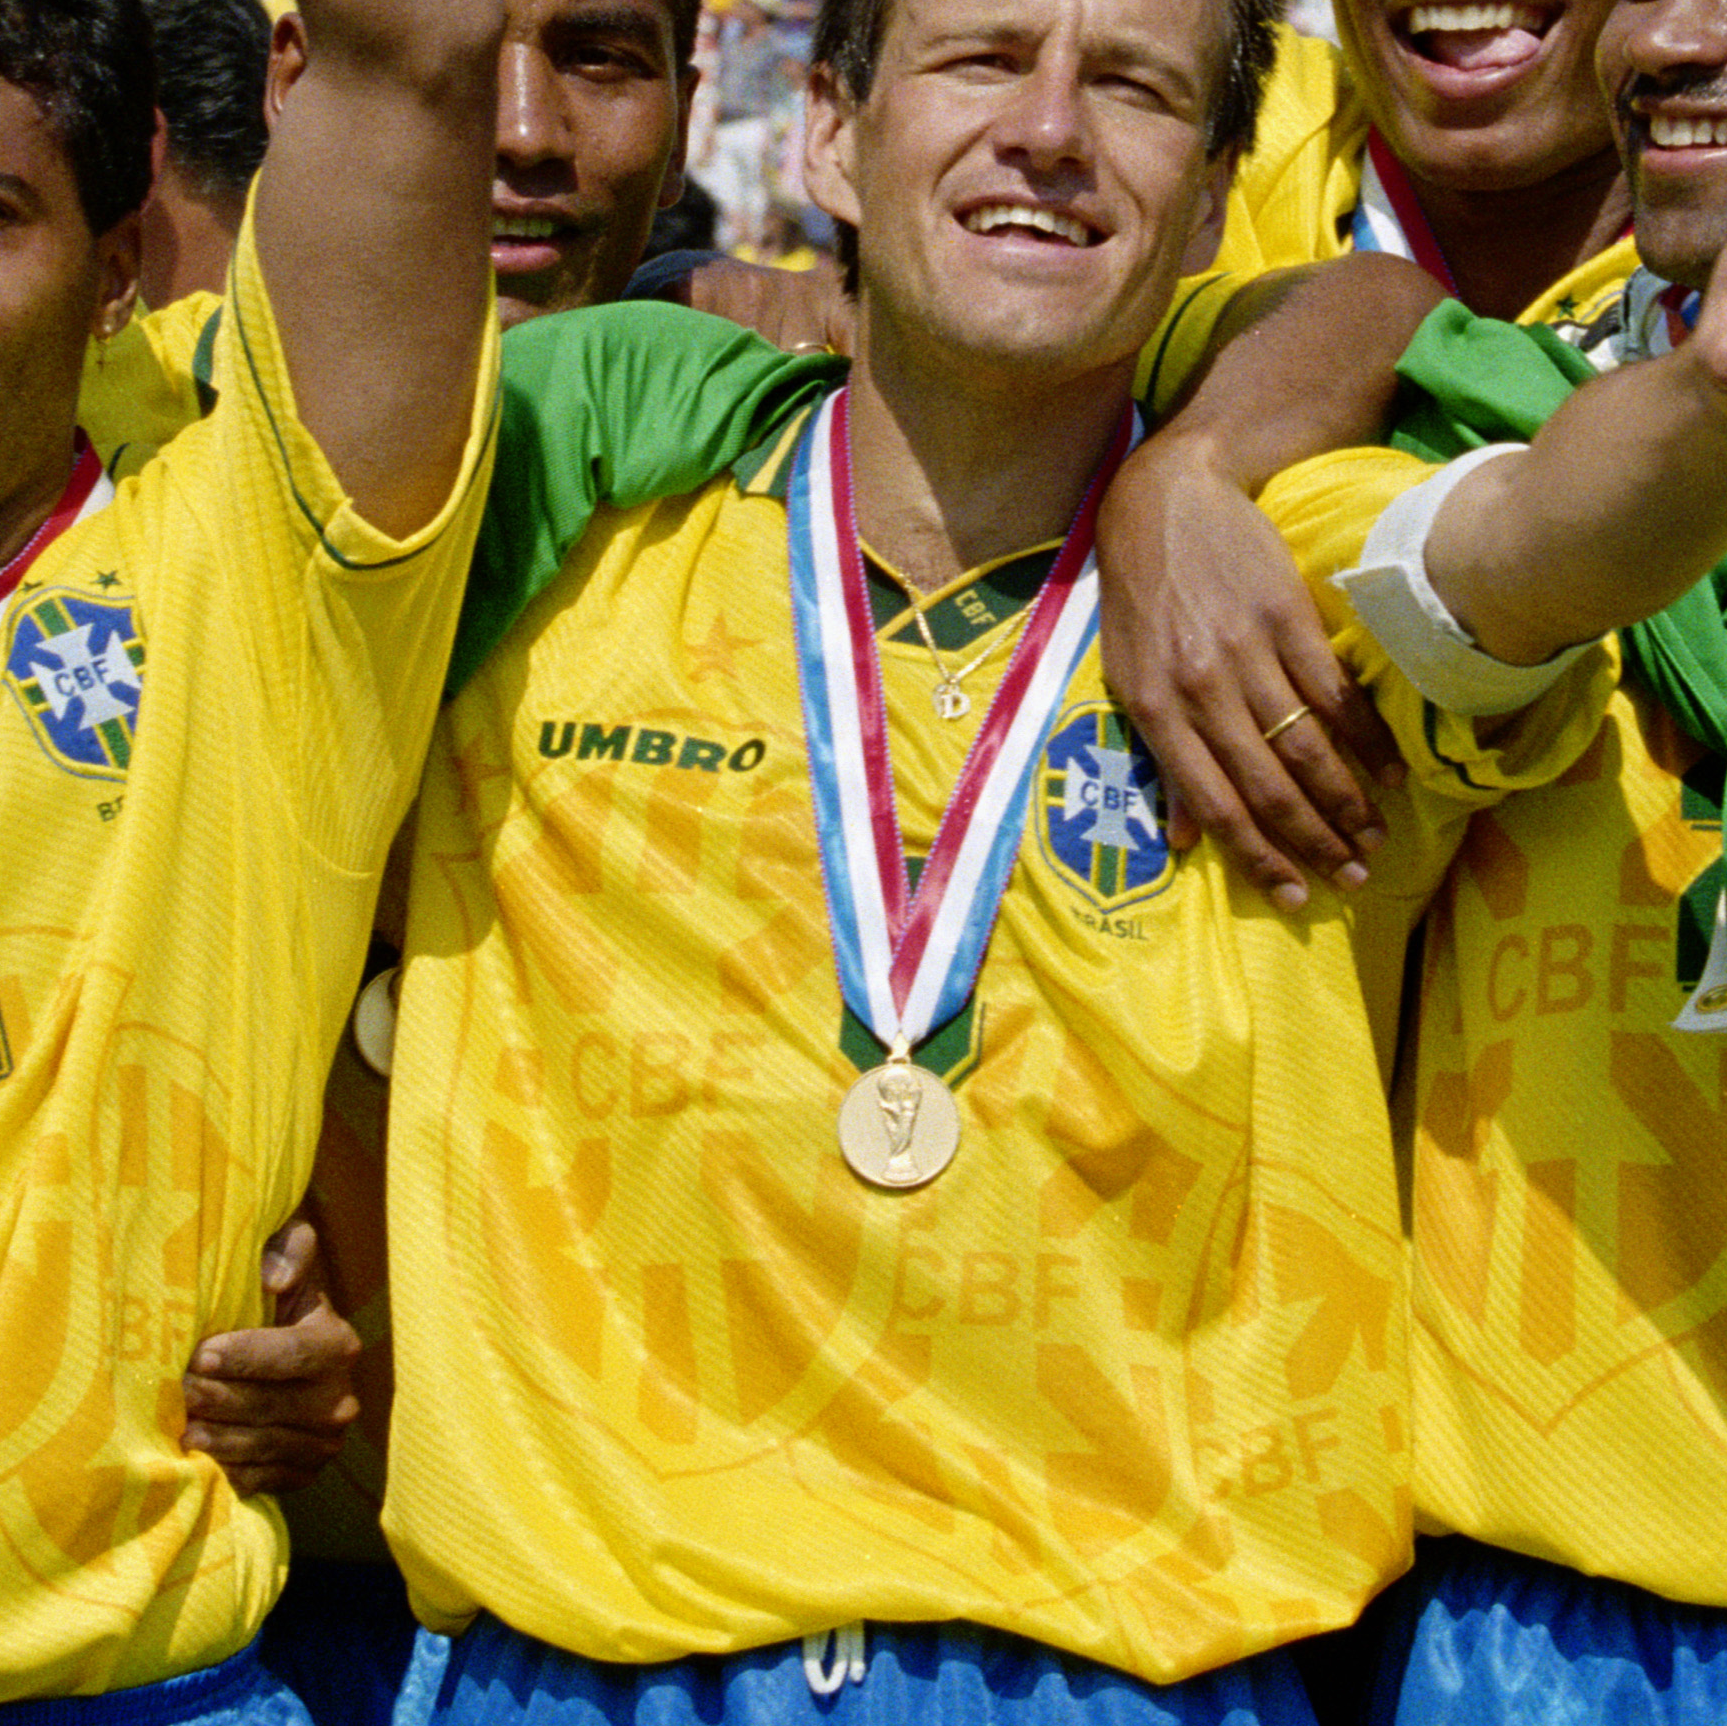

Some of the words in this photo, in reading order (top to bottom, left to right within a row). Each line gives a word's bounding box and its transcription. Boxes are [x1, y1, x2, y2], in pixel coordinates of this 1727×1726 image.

[954, 589, 997, 625] CBF
[54, 658, 110, 698] CBF
[538, 721, 766, 773] UMBRO
[1081, 779, 1138, 814] CBF
[1486, 924, 1671, 1022] CBF
[572, 1031, 765, 1120] CBF
[893, 1249, 1081, 1329] CBF
